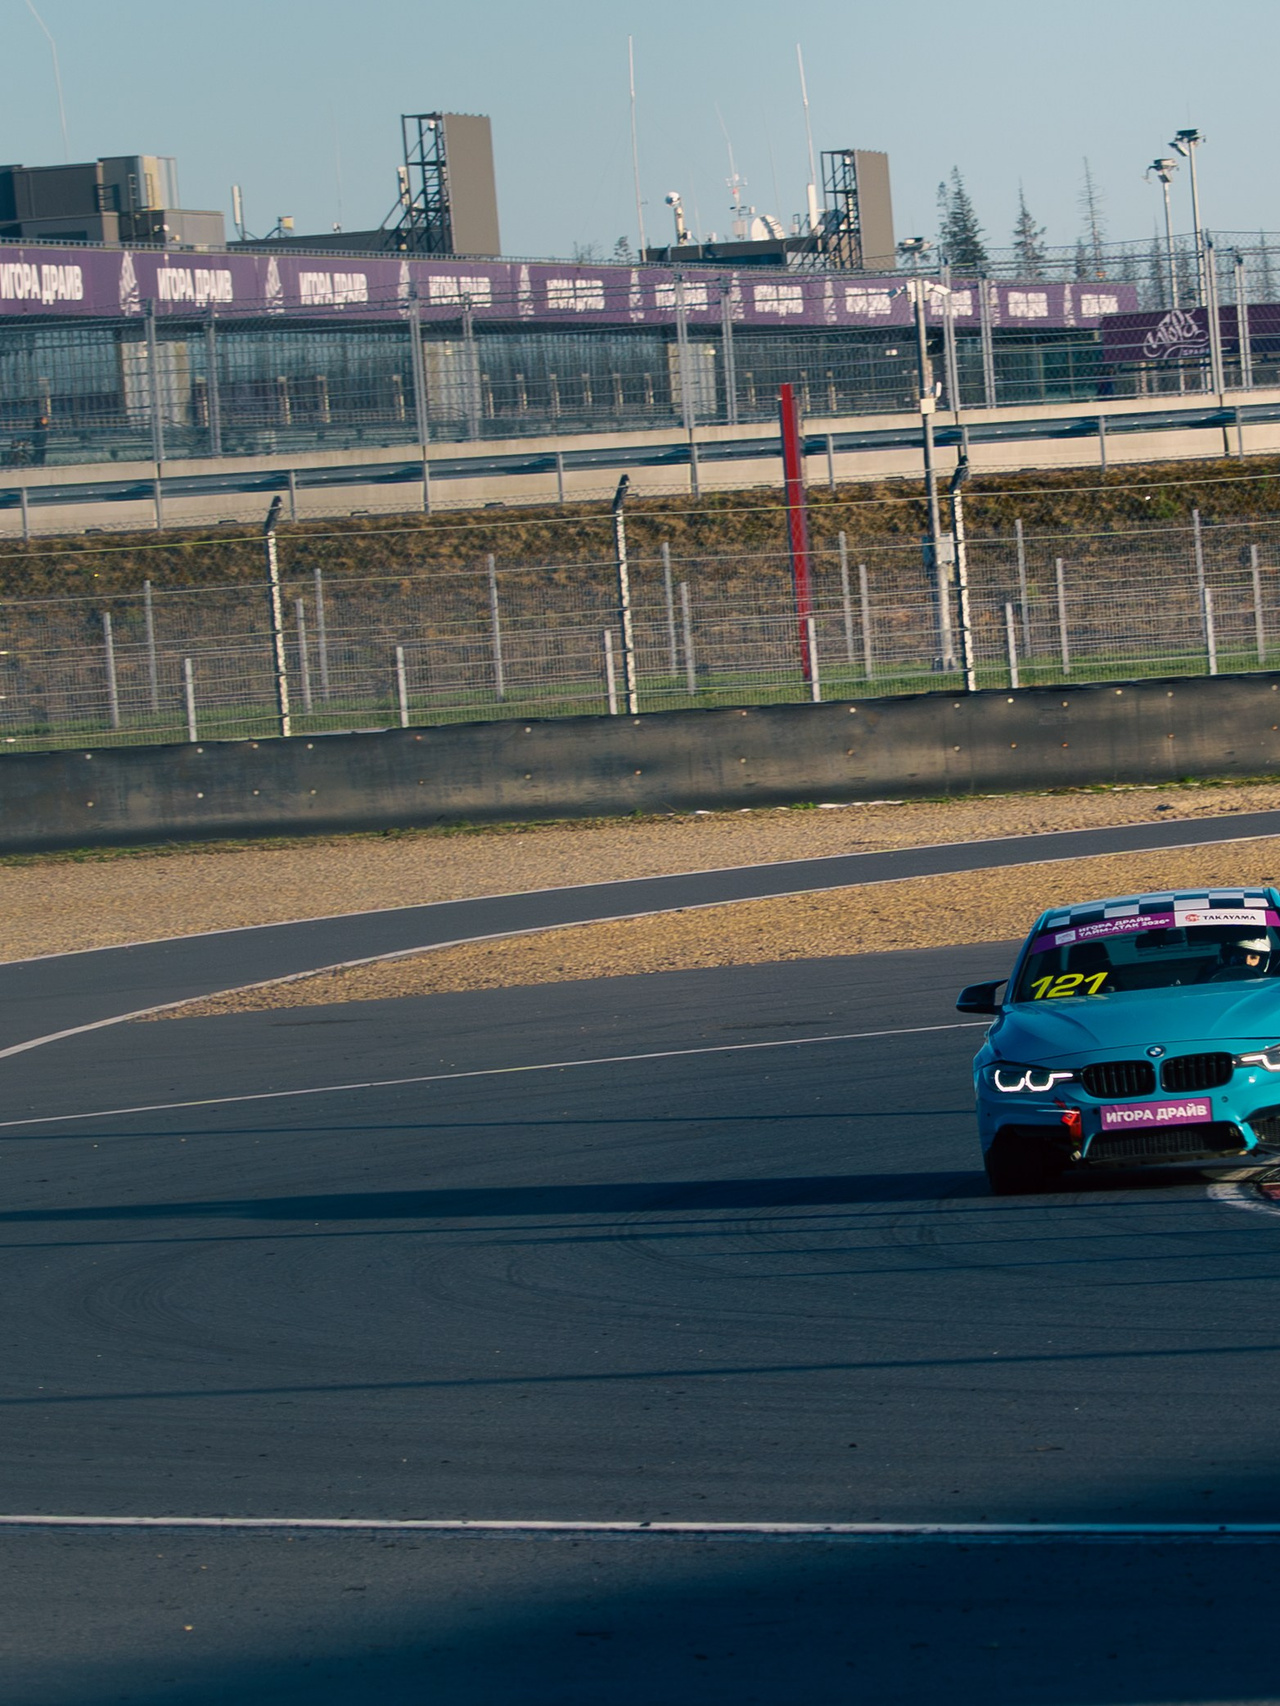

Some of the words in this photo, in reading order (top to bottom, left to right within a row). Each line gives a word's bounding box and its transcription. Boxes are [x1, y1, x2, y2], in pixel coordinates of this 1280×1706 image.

[0, 264, 41, 299] ИГОРА
[157, 267, 195, 302] ИГОРА
[1079, 922, 1113, 933] ИГОРА
[1115, 916, 1152, 926] ДРАЙВ
[1031, 971, 1109, 1000] 121
[1106, 1109, 1154, 1123] ИГОРА
[1156, 1103, 1208, 1120] ДРАЙВ
